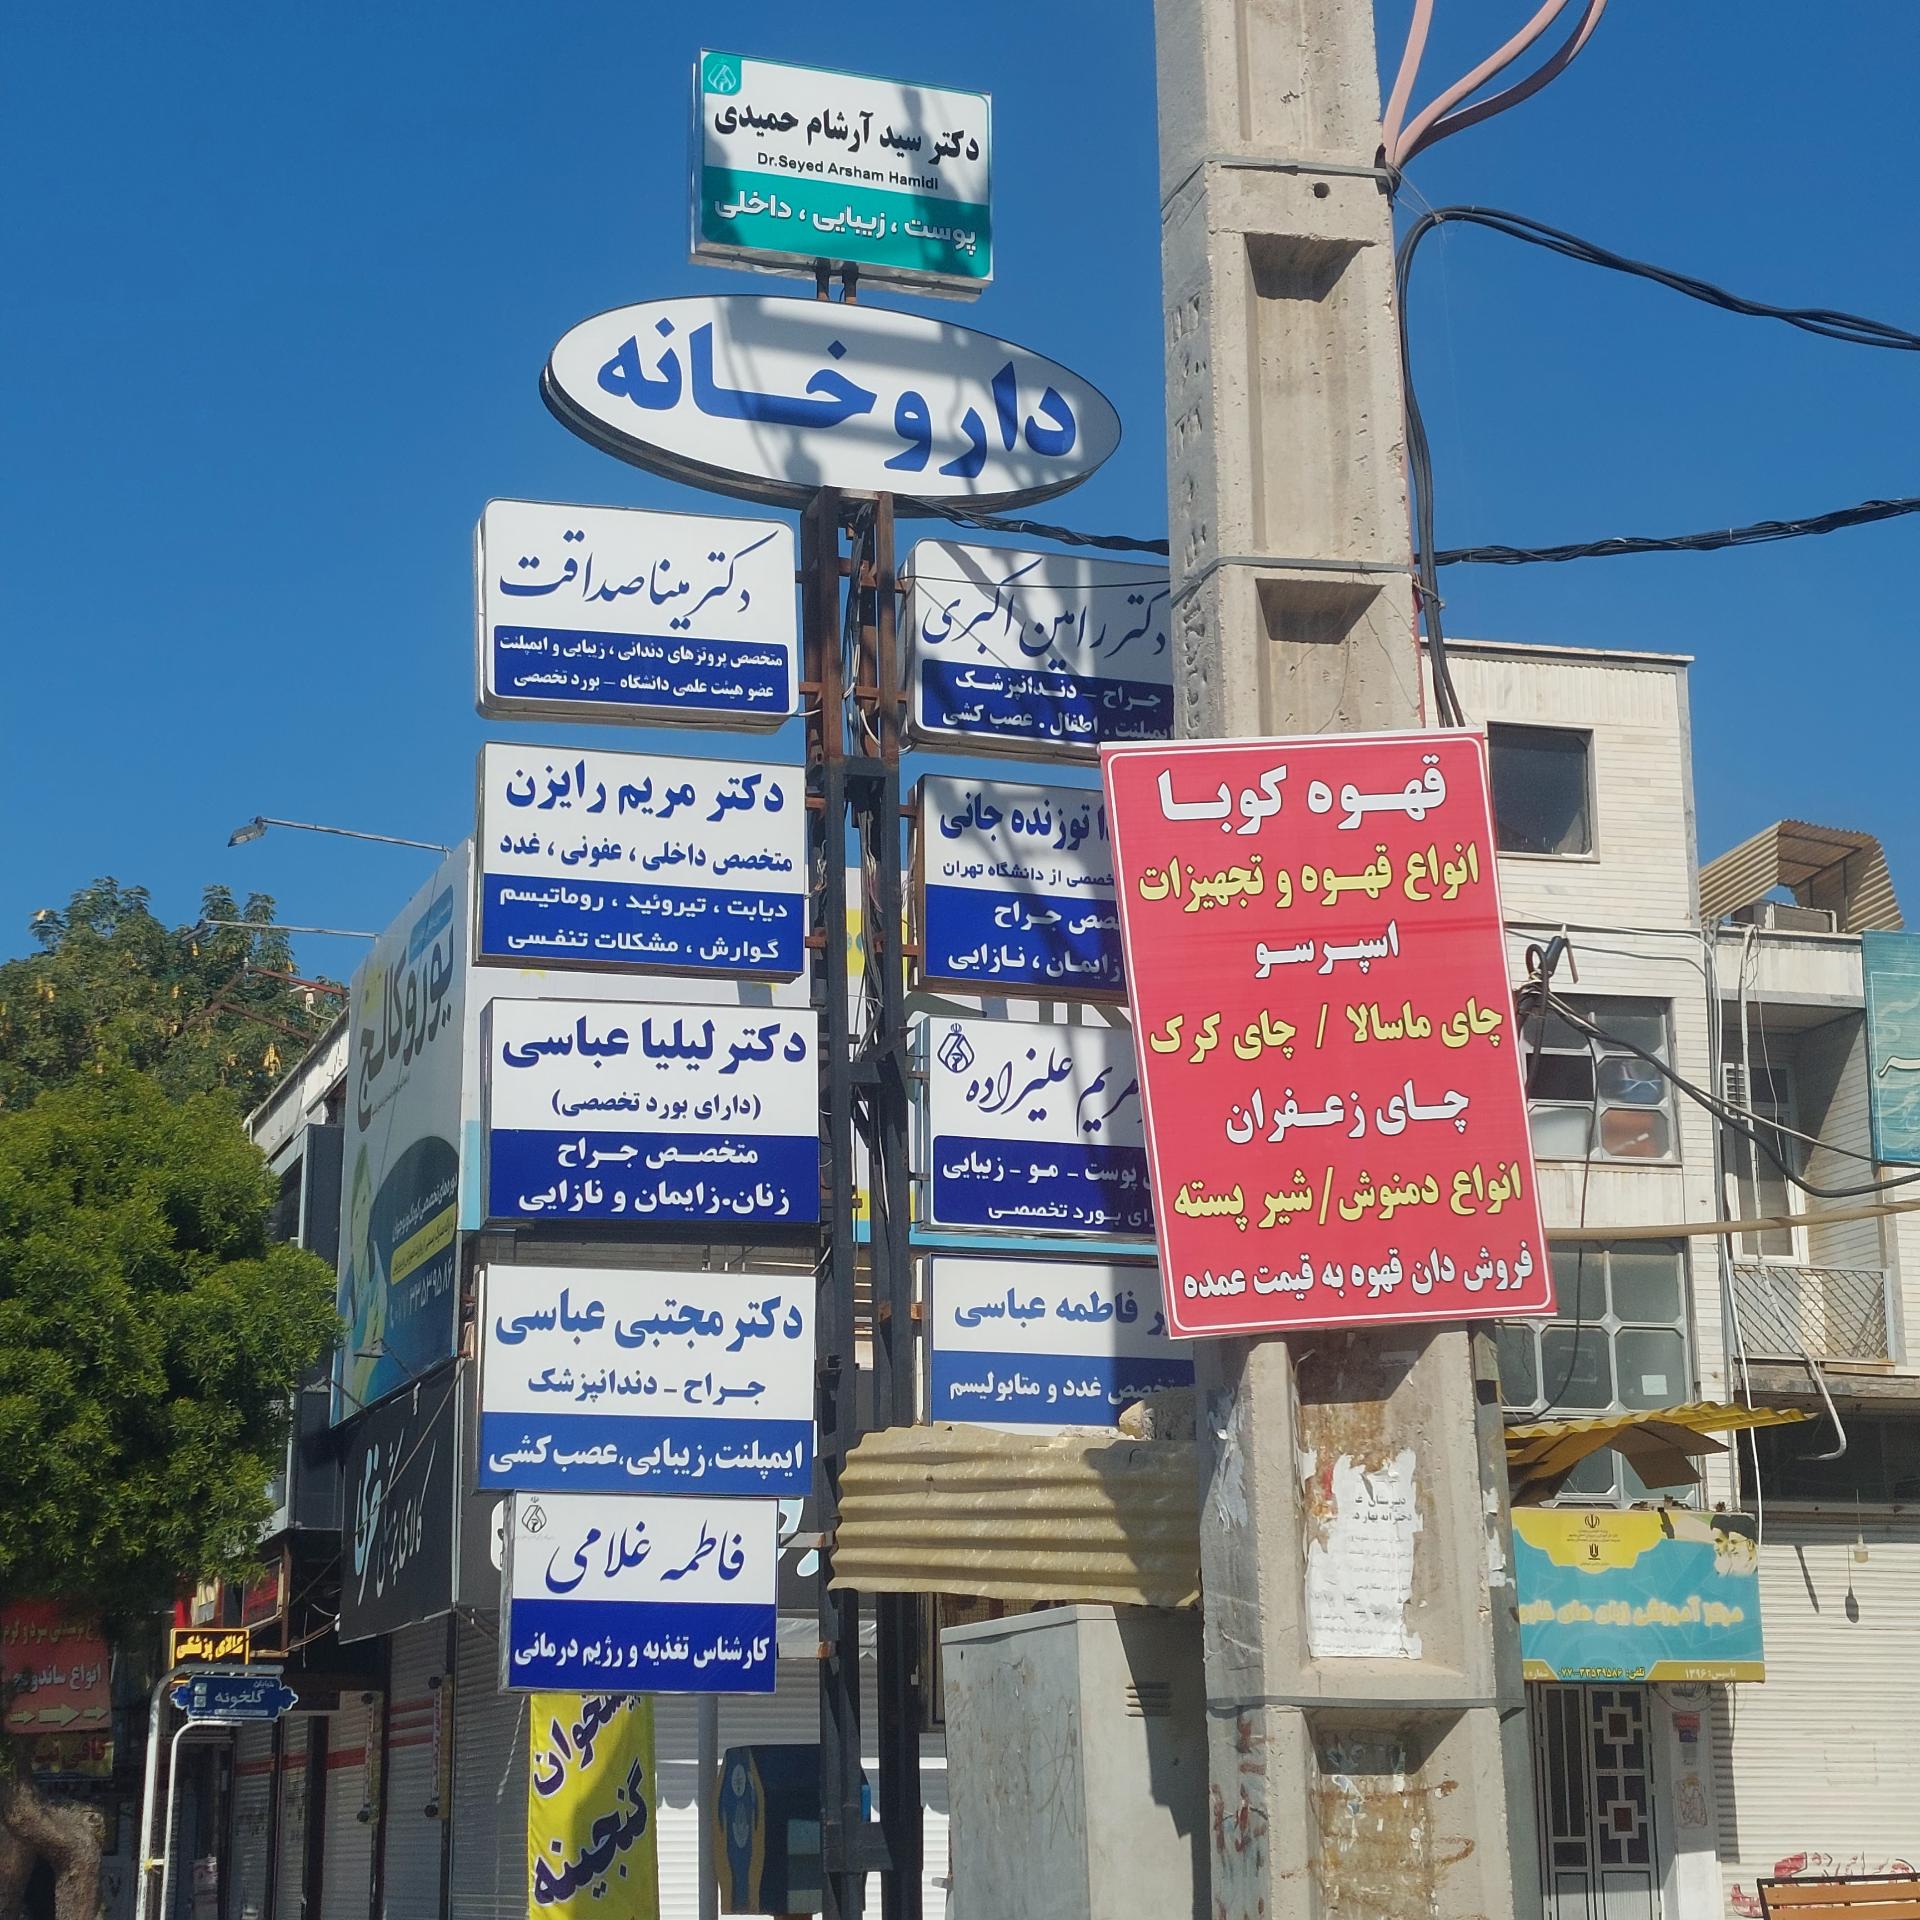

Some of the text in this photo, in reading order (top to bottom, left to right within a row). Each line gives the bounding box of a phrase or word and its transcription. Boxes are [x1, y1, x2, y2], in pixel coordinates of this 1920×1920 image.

[714, 103, 980, 165] دکتر سید آرشام حمیدی
[757, 152, 824, 174] Dr.Seyed
[827, 161, 884, 183] Arsham
[714, 190, 977, 256] پوست زیبایی داخلی
[597, 317, 1077, 478] داروخانه
[499, 529, 778, 630] دکتر مینا صداقت
[921, 558, 1171, 673] دکتر رامین اکبری
[499, 634, 548, 656] ایمپلنت
[552, 645, 559, 658] و
[562, 638, 606, 660] زیبایی
[617, 640, 664, 661] دندانی
[730, 653, 783, 670] متخصص
[513, 668, 774, 701] عضو هیئت علمی دانشگاه بورد تخصصی
[955, 670, 1161, 710] جراح دندانپزشک
[942, 703, 984, 728] کشی
[989, 712, 1033, 729] عصب
[1050, 712, 1099, 736] اطفال
[505, 759, 784, 822] دکتر مریم رایزن
[1157, 765, 1288, 835] کوبا
[1307, 753, 1448, 831] قهوه
[939, 792, 1003, 842] جانی
[1010, 799, 1090, 850] توزنده
[499, 832, 792, 876] متخصص داخلی عفونی غدد
[943, 860, 1114, 888] خصصی از دانشگاه تهران
[1138, 841, 1480, 913] انواع قهوه و تجهیزات
[500, 887, 788, 922] دیابت تیروئید روماتیسم
[994, 900, 1062, 931] جراح
[507, 928, 780, 963] گوارش مشکلات تنفسی
[947, 943, 1121, 982] زایمان نازایی
[1254, 919, 1400, 979] اسپرسو
[358, 922, 454, 1133] یوروکالج
[1233, 1009, 1297, 1060] چای
[1345, 1000, 1432, 1043] ماسالا
[1441, 997, 1503, 1048] چای
[502, 1015, 807, 1075] دکتر لیلیا عباسی
[965, 1046, 1073, 1122] علیزاده
[552, 1088, 761, 1121] (دارای بورد تخصصی)
[1225, 1079, 1470, 1144] چای زعفران
[557, 1136, 759, 1169] متخصص جراح
[942, 1151, 1003, 1182] زیبایی
[1027, 1164, 1058, 1183] مو
[1084, 1159, 1136, 1190] پوست
[1449, 1160, 1522, 1216] انواع
[518, 1178, 603, 1212] نازایی
[610, 1190, 627, 1212] و
[988, 1202, 1068, 1220] تخصصی
[1174, 1179, 1245, 1231] پسته
[1072, 1208, 1121, 1225] بورد
[1183, 1240, 1534, 1301] فروش دان قهوه به قیمت عمده
[495, 1287, 803, 1352] دکتر مجتبی عباسی
[954, 1287, 1138, 1328] فاطمه عباسی
[527, 1367, 767, 1406] جراح دندانپزشک
[950, 1370, 1040, 1402] متابولیسم
[1046, 1386, 1057, 1403] و
[1063, 1378, 1102, 1397] غدد
[488, 1434, 552, 1473] کشی
[553, 1443, 617, 1473] عصب
[545, 1520, 651, 1594] غلامی
[659, 1519, 745, 1582] فاطمه
[514, 1632, 770, 1669] کارشناس تغذیه و رژیم درمانی
[214, 1689, 265, 1708] گلخونه
